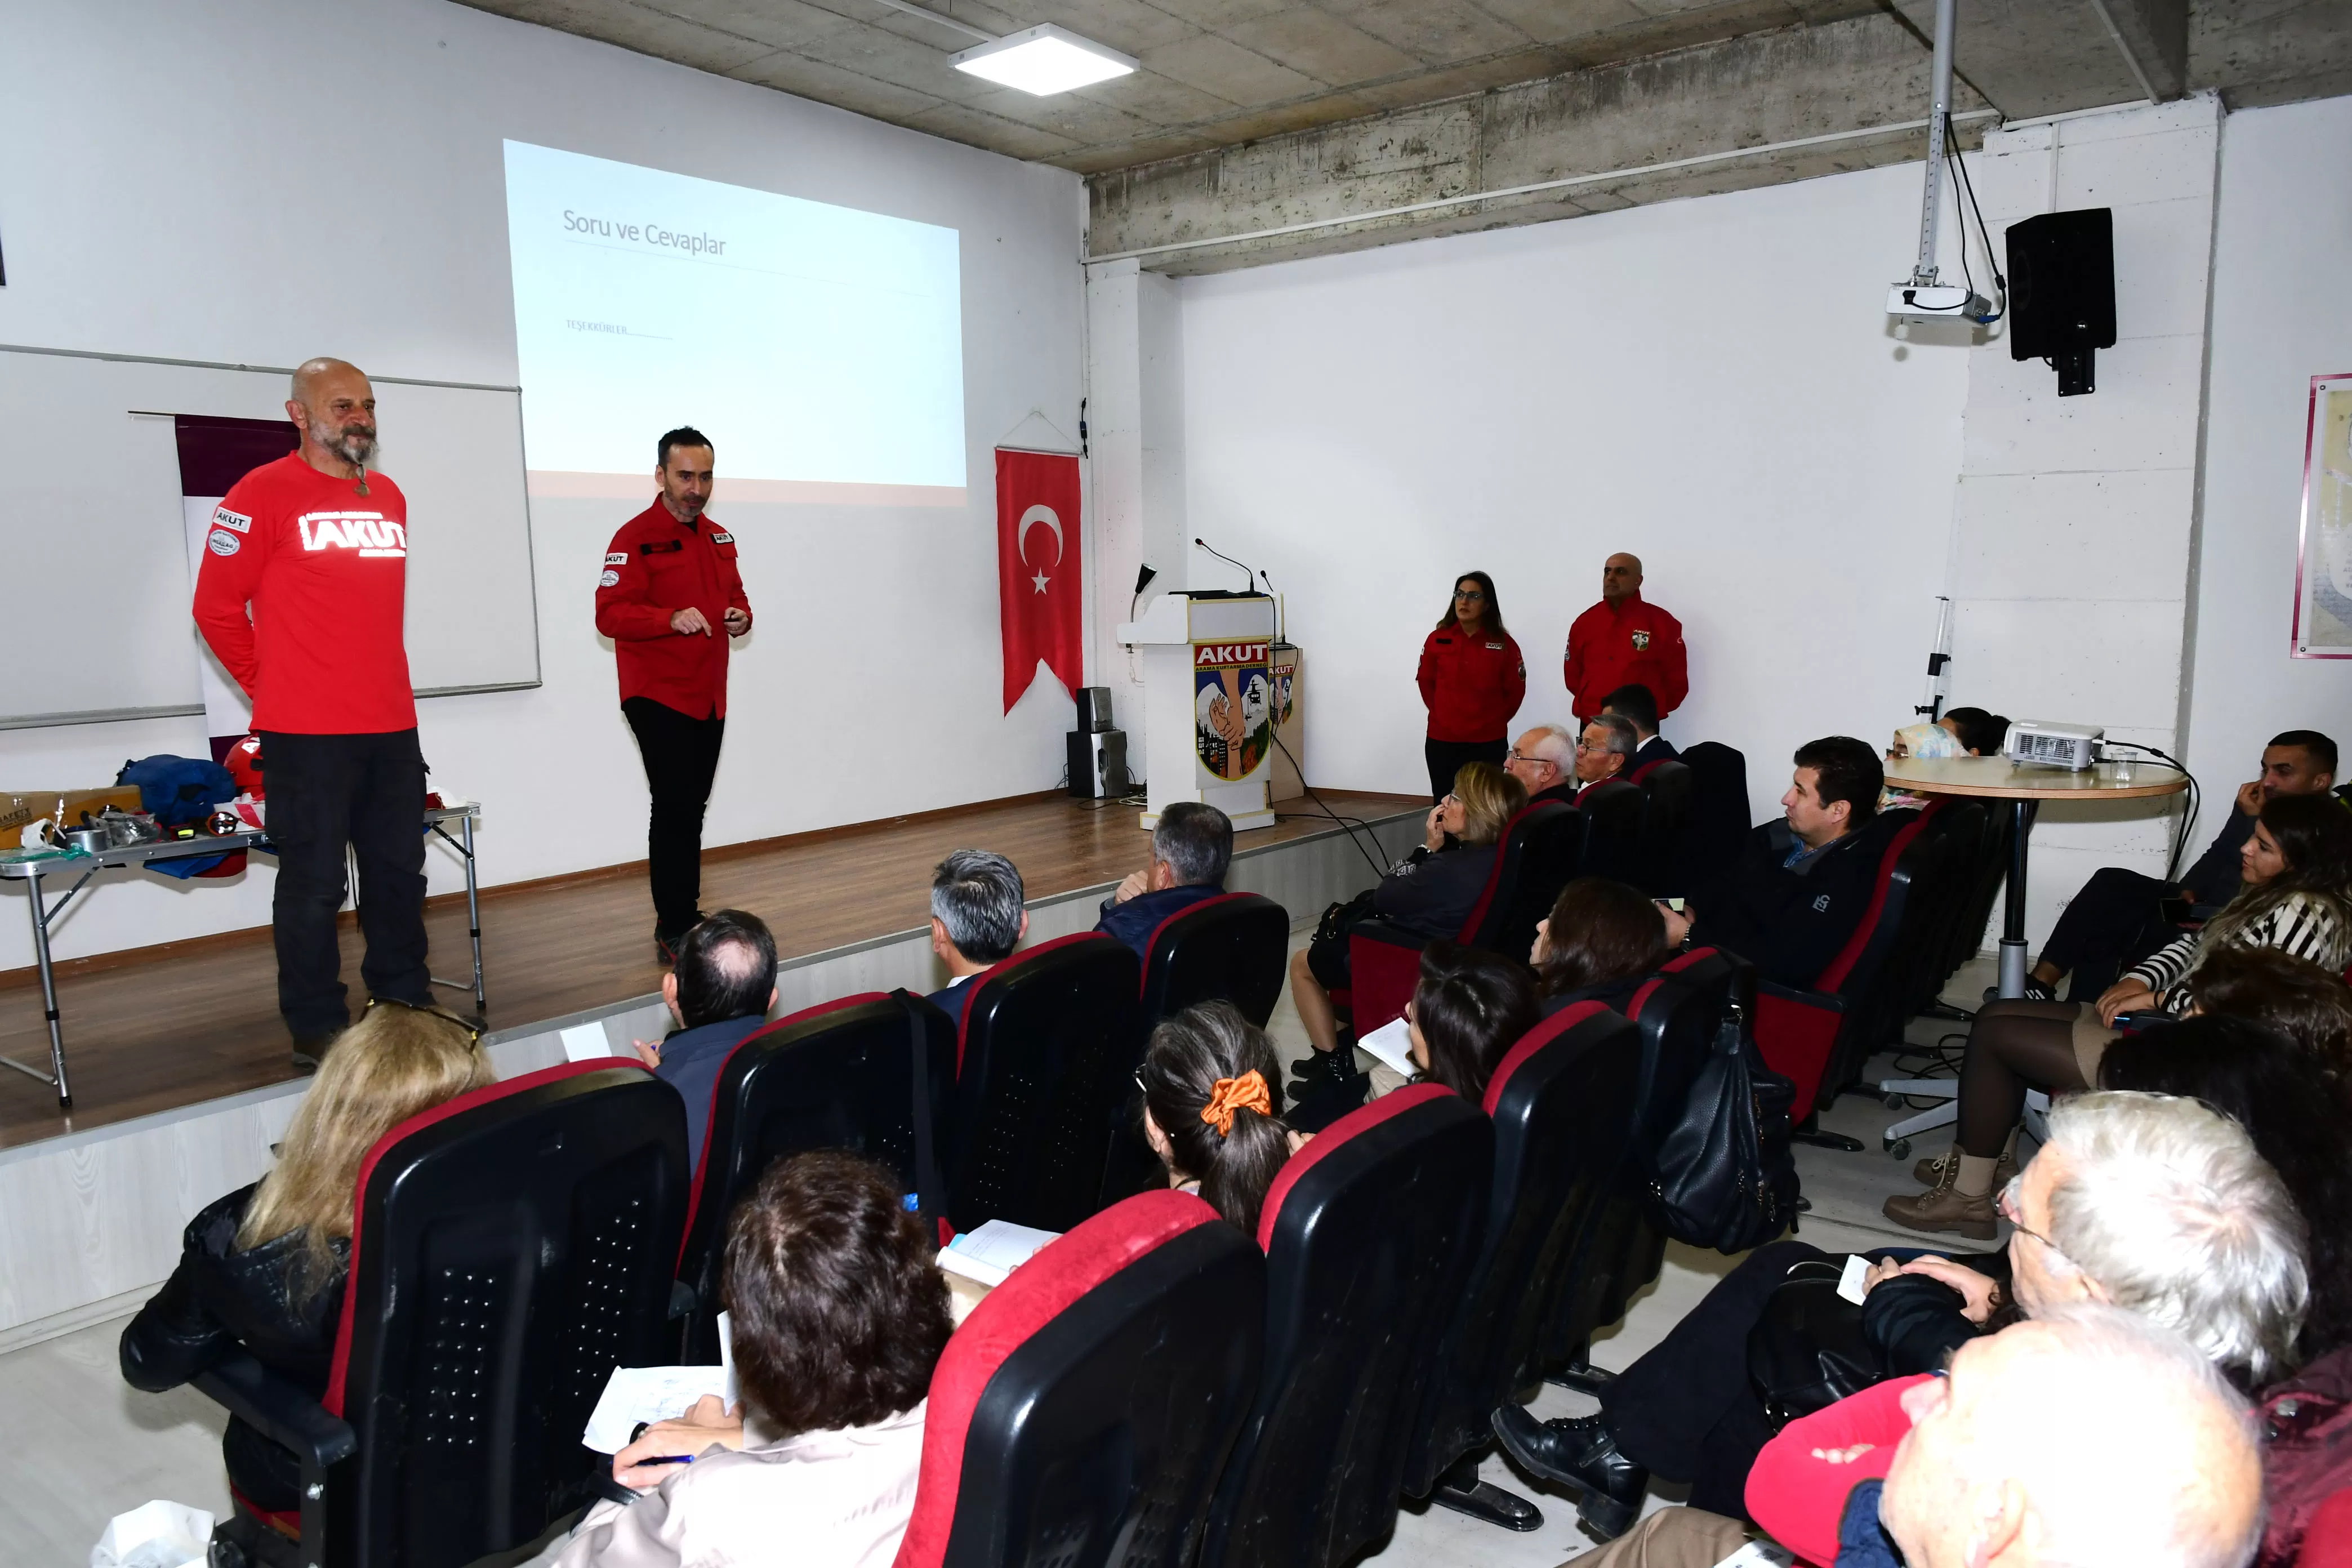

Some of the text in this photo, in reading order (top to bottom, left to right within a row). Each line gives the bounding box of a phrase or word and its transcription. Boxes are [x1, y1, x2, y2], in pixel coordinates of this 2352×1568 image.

[564, 210, 727, 256] Soru ve Cevaplar
[217, 512, 246, 527] AKUT
[310, 520, 407, 551] AKUT
[1196, 644, 1267, 664] AKUT
[1269, 665, 1293, 675] AKUT
